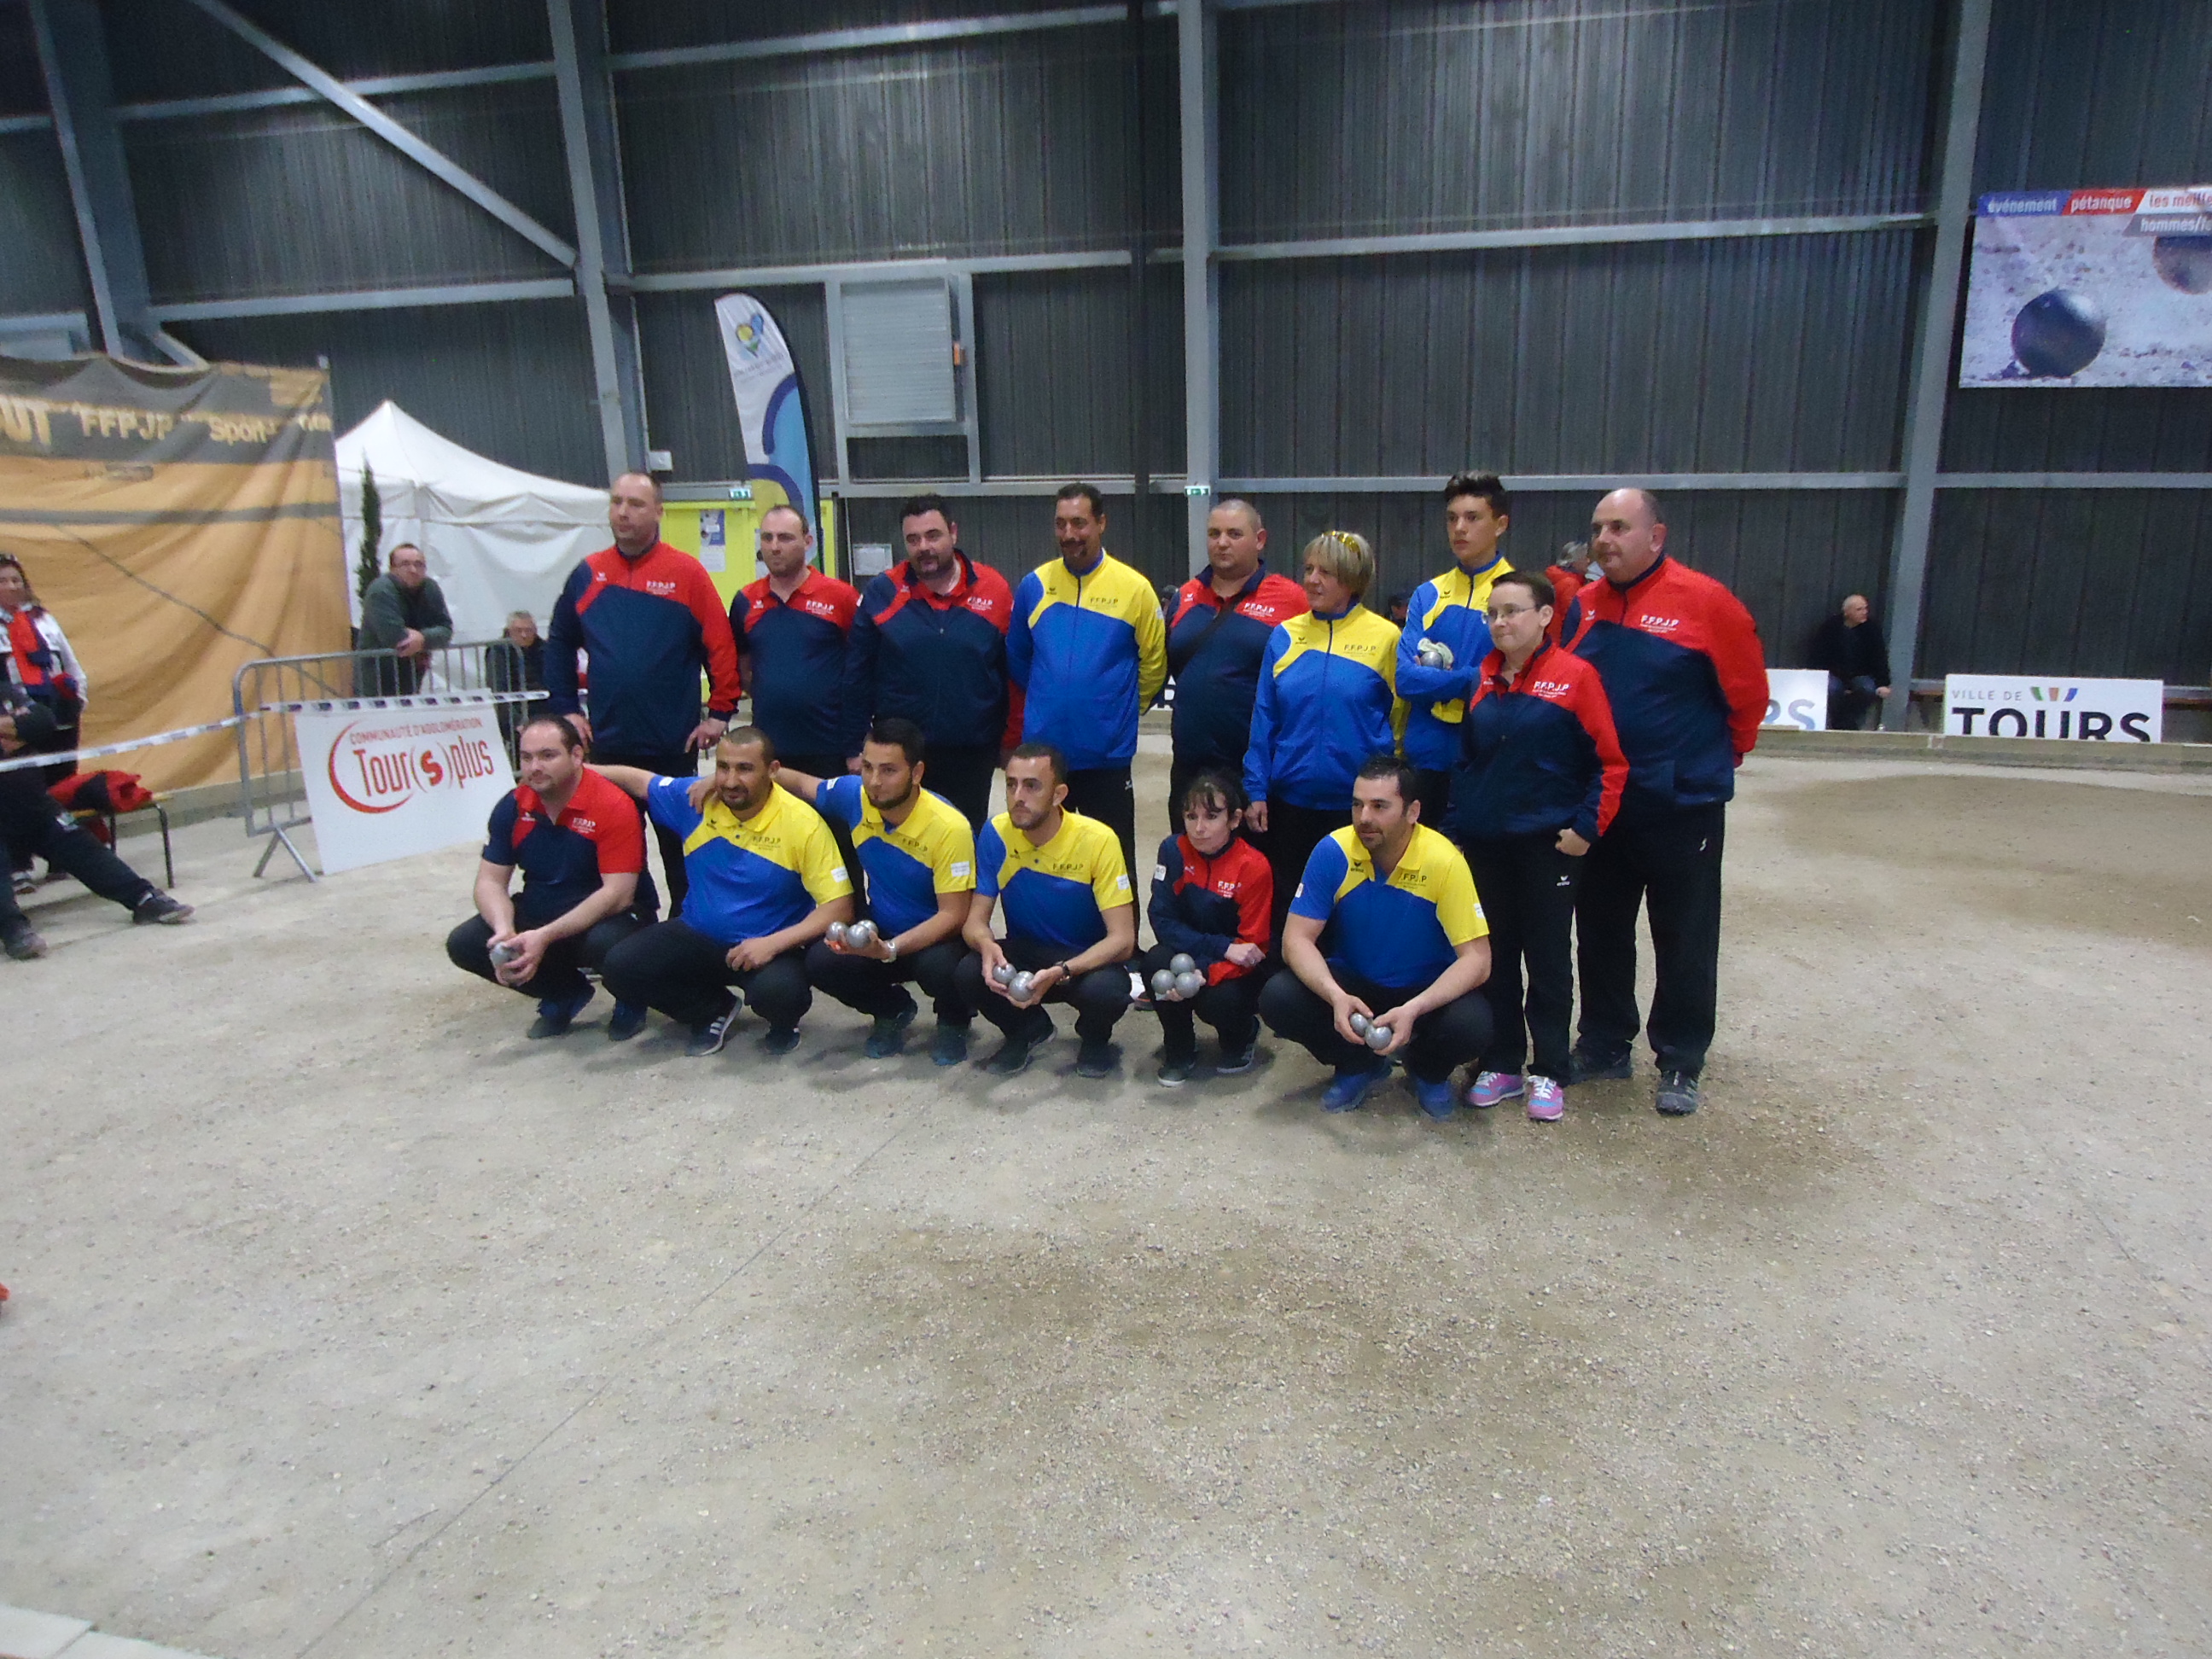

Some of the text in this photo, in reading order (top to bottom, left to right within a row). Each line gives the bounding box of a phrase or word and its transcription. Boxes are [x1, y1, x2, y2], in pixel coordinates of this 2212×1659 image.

[1988, 197, 2057, 213] événement
[2070, 195, 2132, 212] pétanque
[2150, 195, 2169, 207] les
[1952, 690, 2023, 701] VILLE DE
[1952, 707, 2151, 742] TOURS
